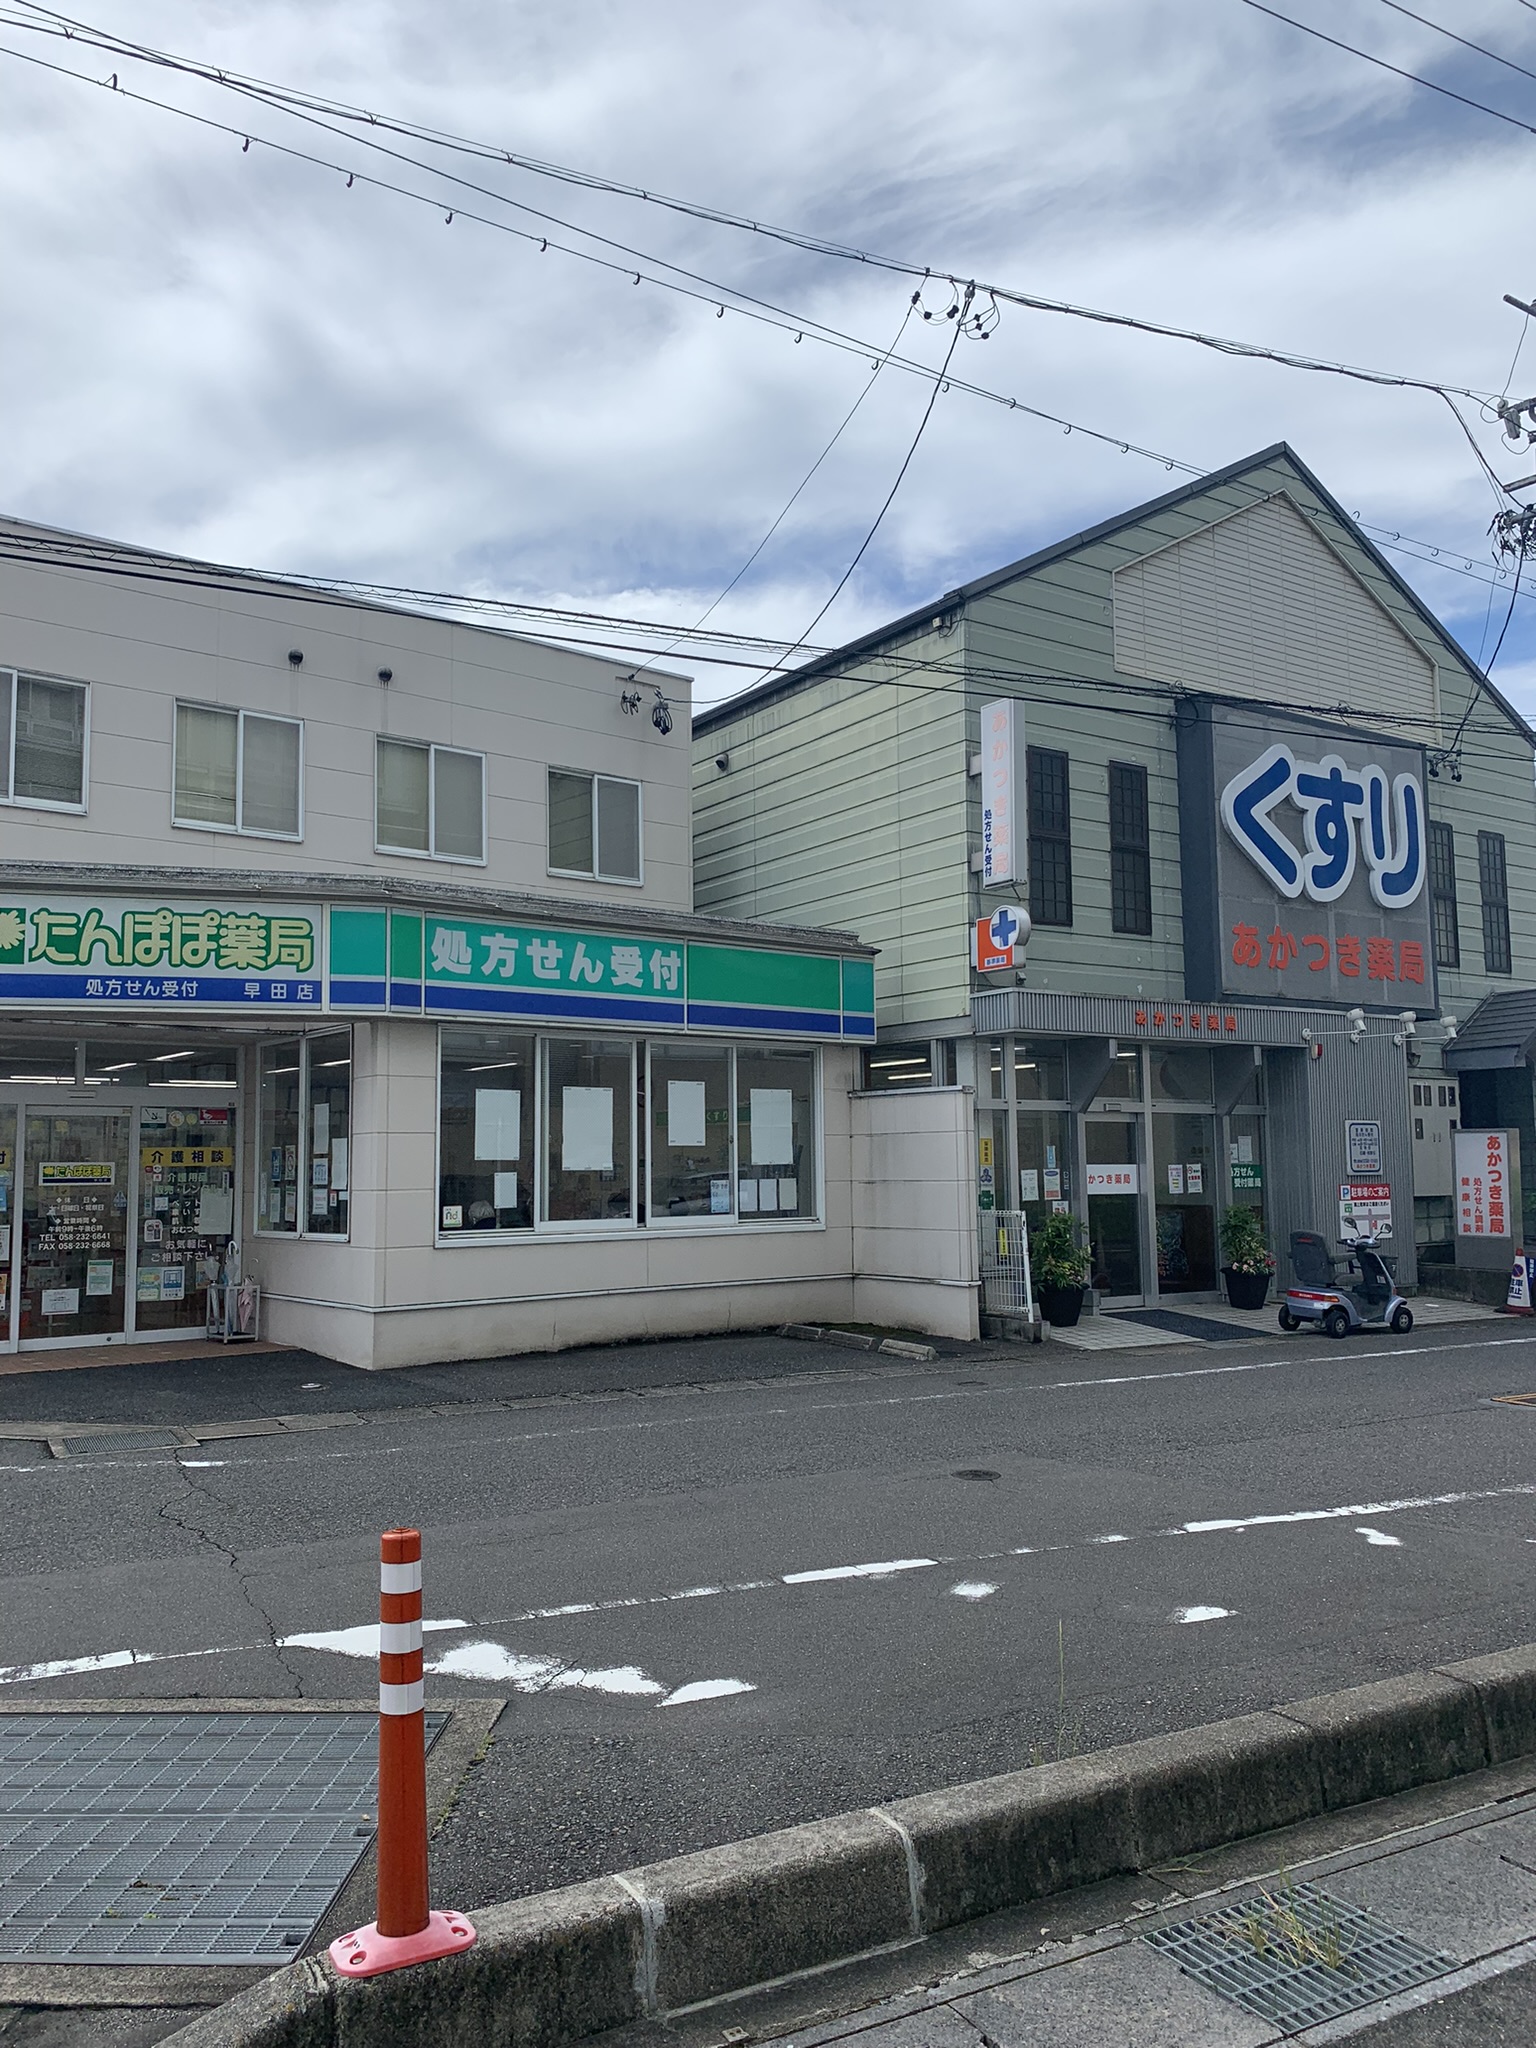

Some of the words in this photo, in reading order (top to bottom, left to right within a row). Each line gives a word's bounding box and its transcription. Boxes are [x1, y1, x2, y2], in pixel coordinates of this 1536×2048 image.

[991, 710, 1009, 875] あかつき薬局
[984, 808, 992, 878] 処方せん受付
[1221, 743, 1427, 909] くすり
[29, 906, 315, 973] たんぽぽ薬局
[432, 927, 682, 991] 処方せん受付
[1232, 921, 1426, 985] あかつき薬局
[86, 979, 198, 998] 処方せん受付
[244, 982, 313, 1000] 早田店
[1135, 1010, 1236, 1031] あかつき薬局
[151, 1150, 224, 1163] 介護相談
[1231, 1167, 1255, 1176] 方せん
[1487, 1135, 1505, 1234] あかつき薬局
